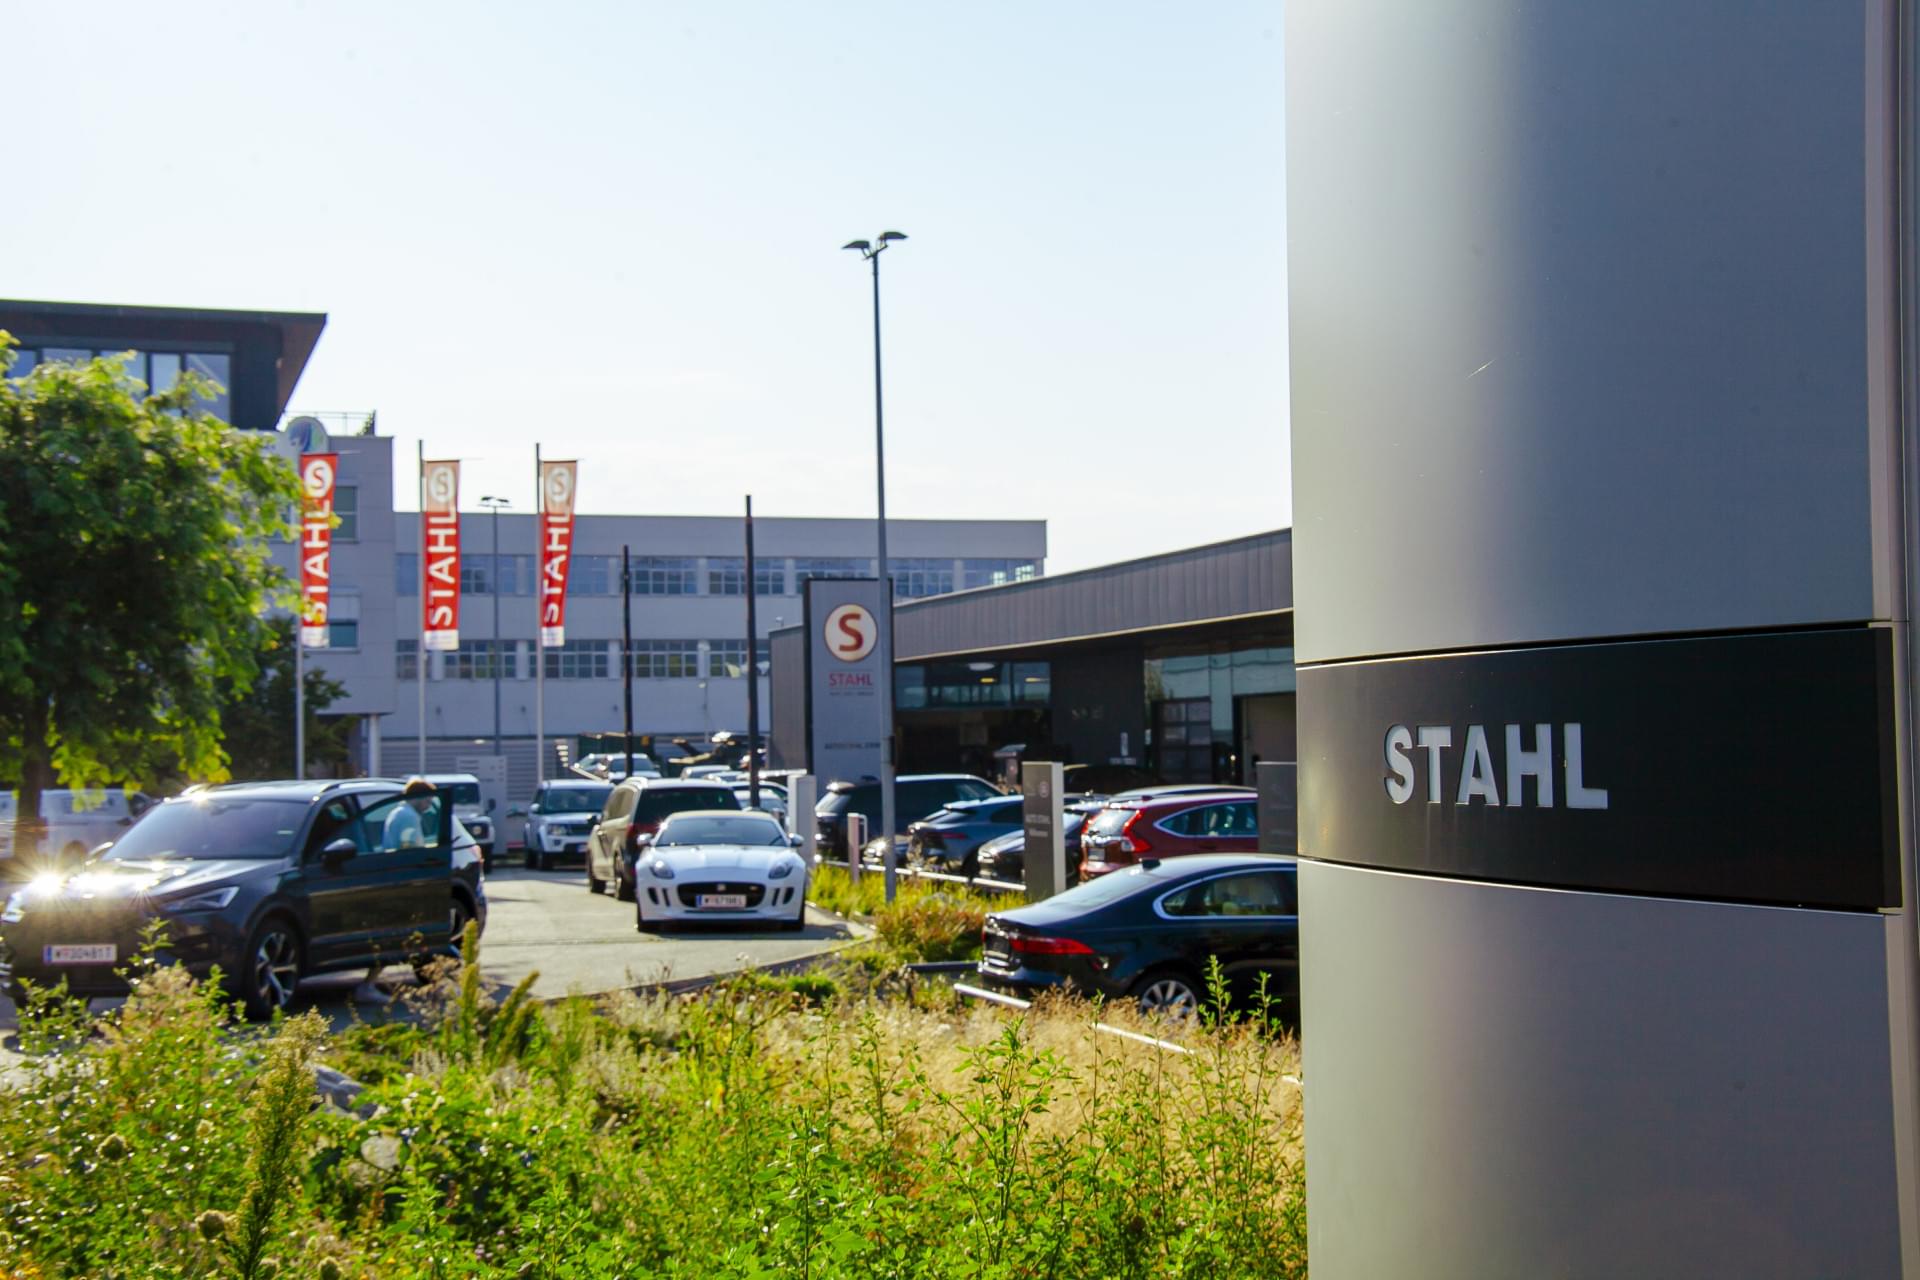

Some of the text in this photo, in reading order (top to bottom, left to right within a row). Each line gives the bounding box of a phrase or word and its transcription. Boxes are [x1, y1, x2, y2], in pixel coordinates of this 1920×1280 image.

[303, 499, 331, 624] STAHL
[428, 505, 457, 627] STAHL
[543, 504, 571, 624] STAHL
[829, 673, 873, 687] STAHL
[838, 612, 864, 652] S
[1384, 723, 1608, 810] STAHL
